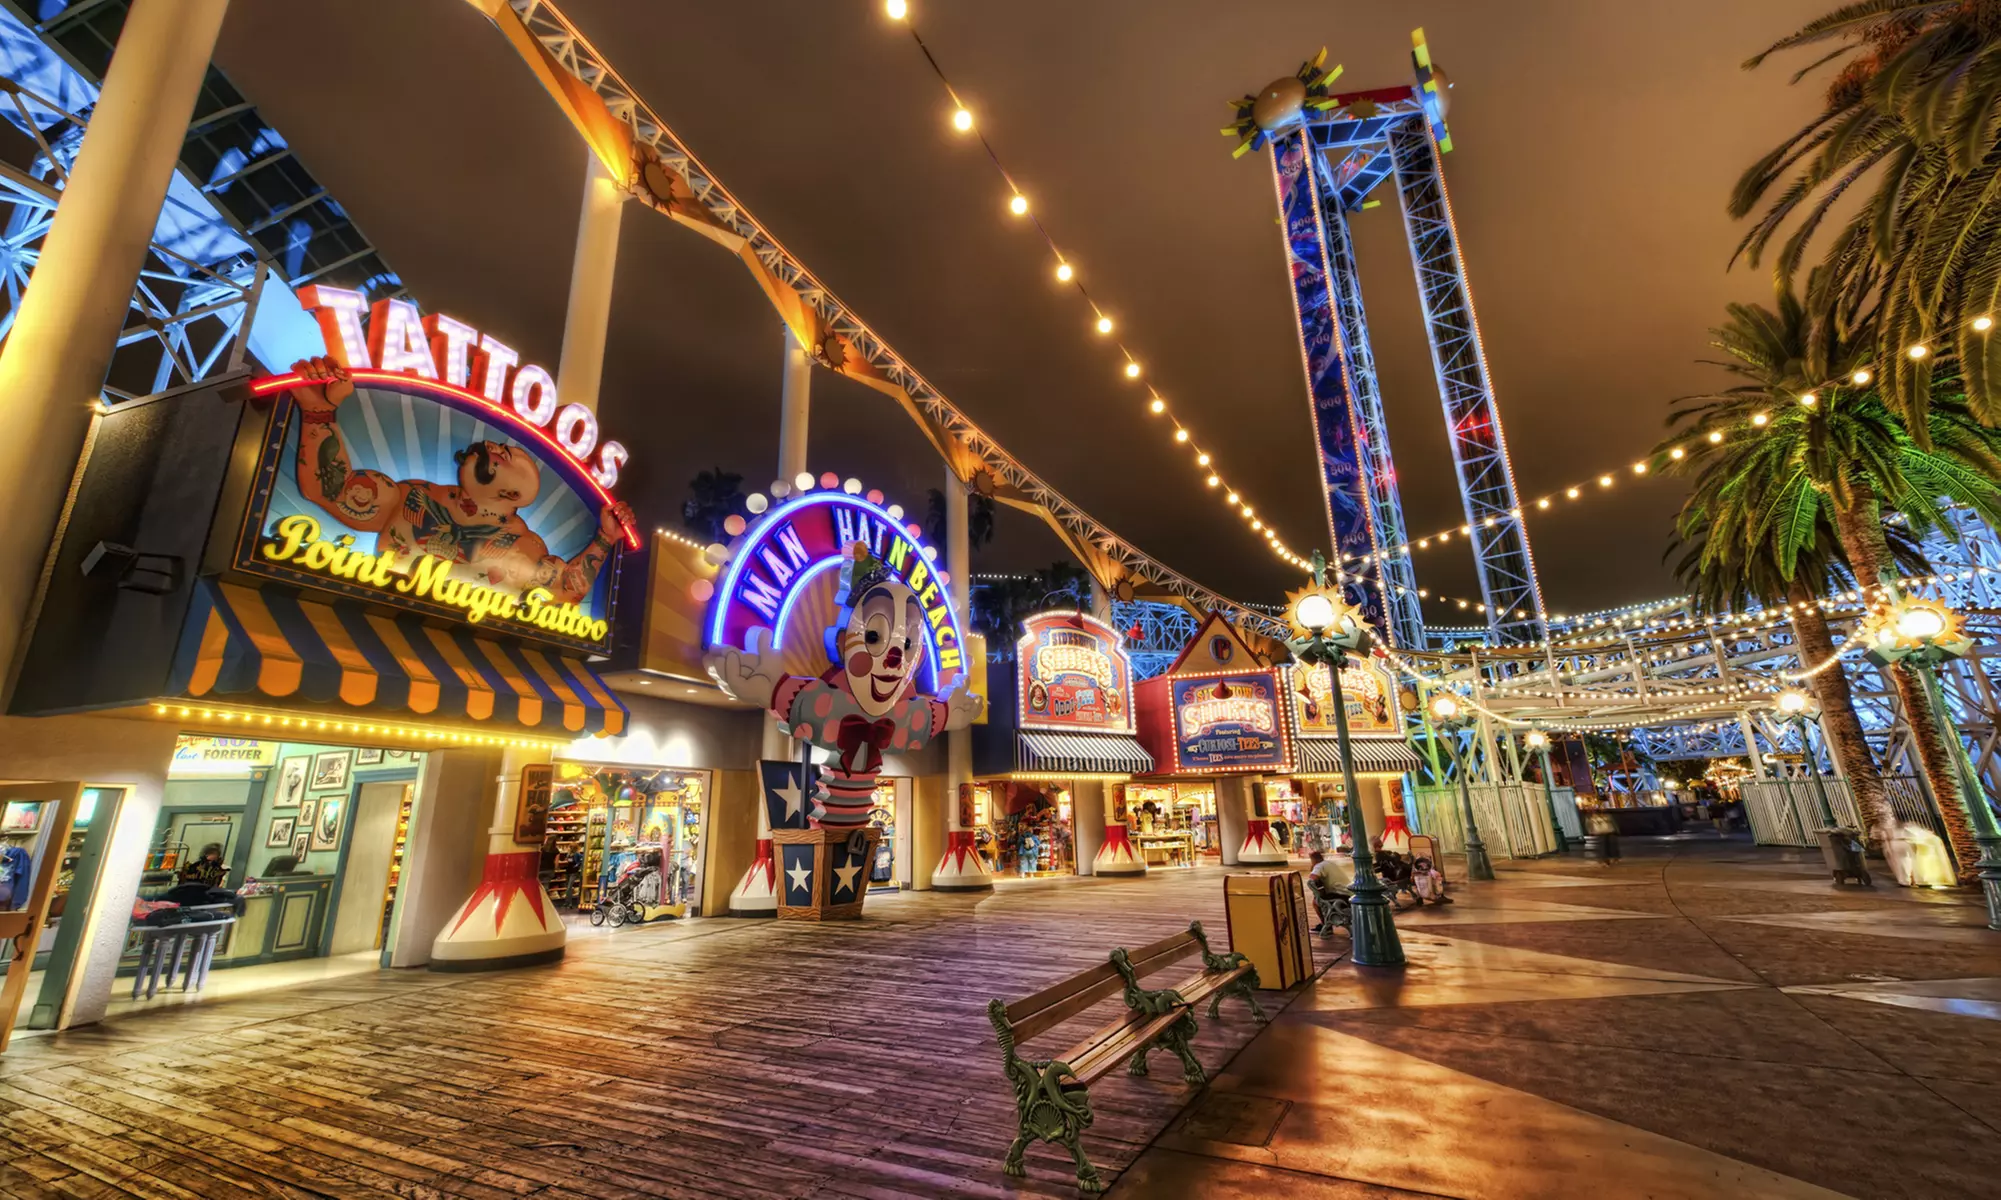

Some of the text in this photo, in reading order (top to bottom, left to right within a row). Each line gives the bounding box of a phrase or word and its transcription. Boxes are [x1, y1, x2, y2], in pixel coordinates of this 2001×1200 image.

[297, 284, 630, 489] TATTOOS
[264, 515, 608, 641] Point Mugu Tattoo
[739, 521, 811, 621] MAN
[833, 506, 888, 556] HAT
[909, 559, 960, 670] BEACH
[1360, 604, 1378, 618] 00
[203, 749, 262, 761] FOREVER
[1184, 701, 1273, 735] SHIRTS
